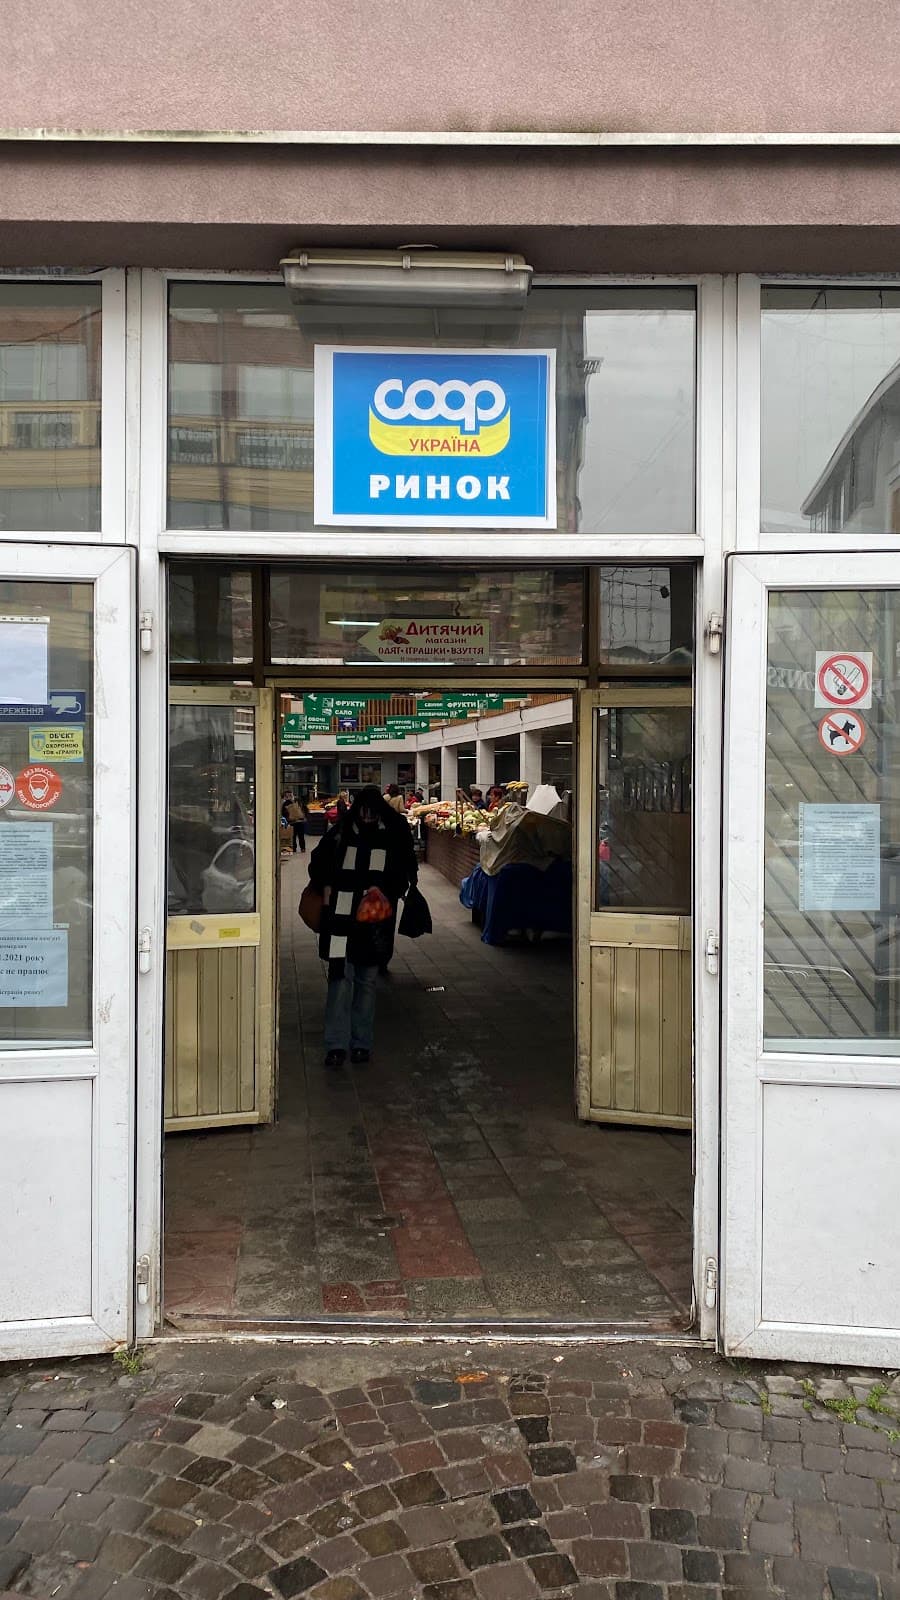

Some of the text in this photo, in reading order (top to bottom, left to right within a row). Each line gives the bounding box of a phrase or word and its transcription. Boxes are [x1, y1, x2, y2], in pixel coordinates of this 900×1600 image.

[408, 435, 481, 453] УКРАЇНА
[368, 473, 512, 500] РИНОК
[405, 621, 484, 636] Дитячий
[450, 646, 484, 655] ВЗУТТЯ
[335, 700, 366, 708] ФРУКТИ
